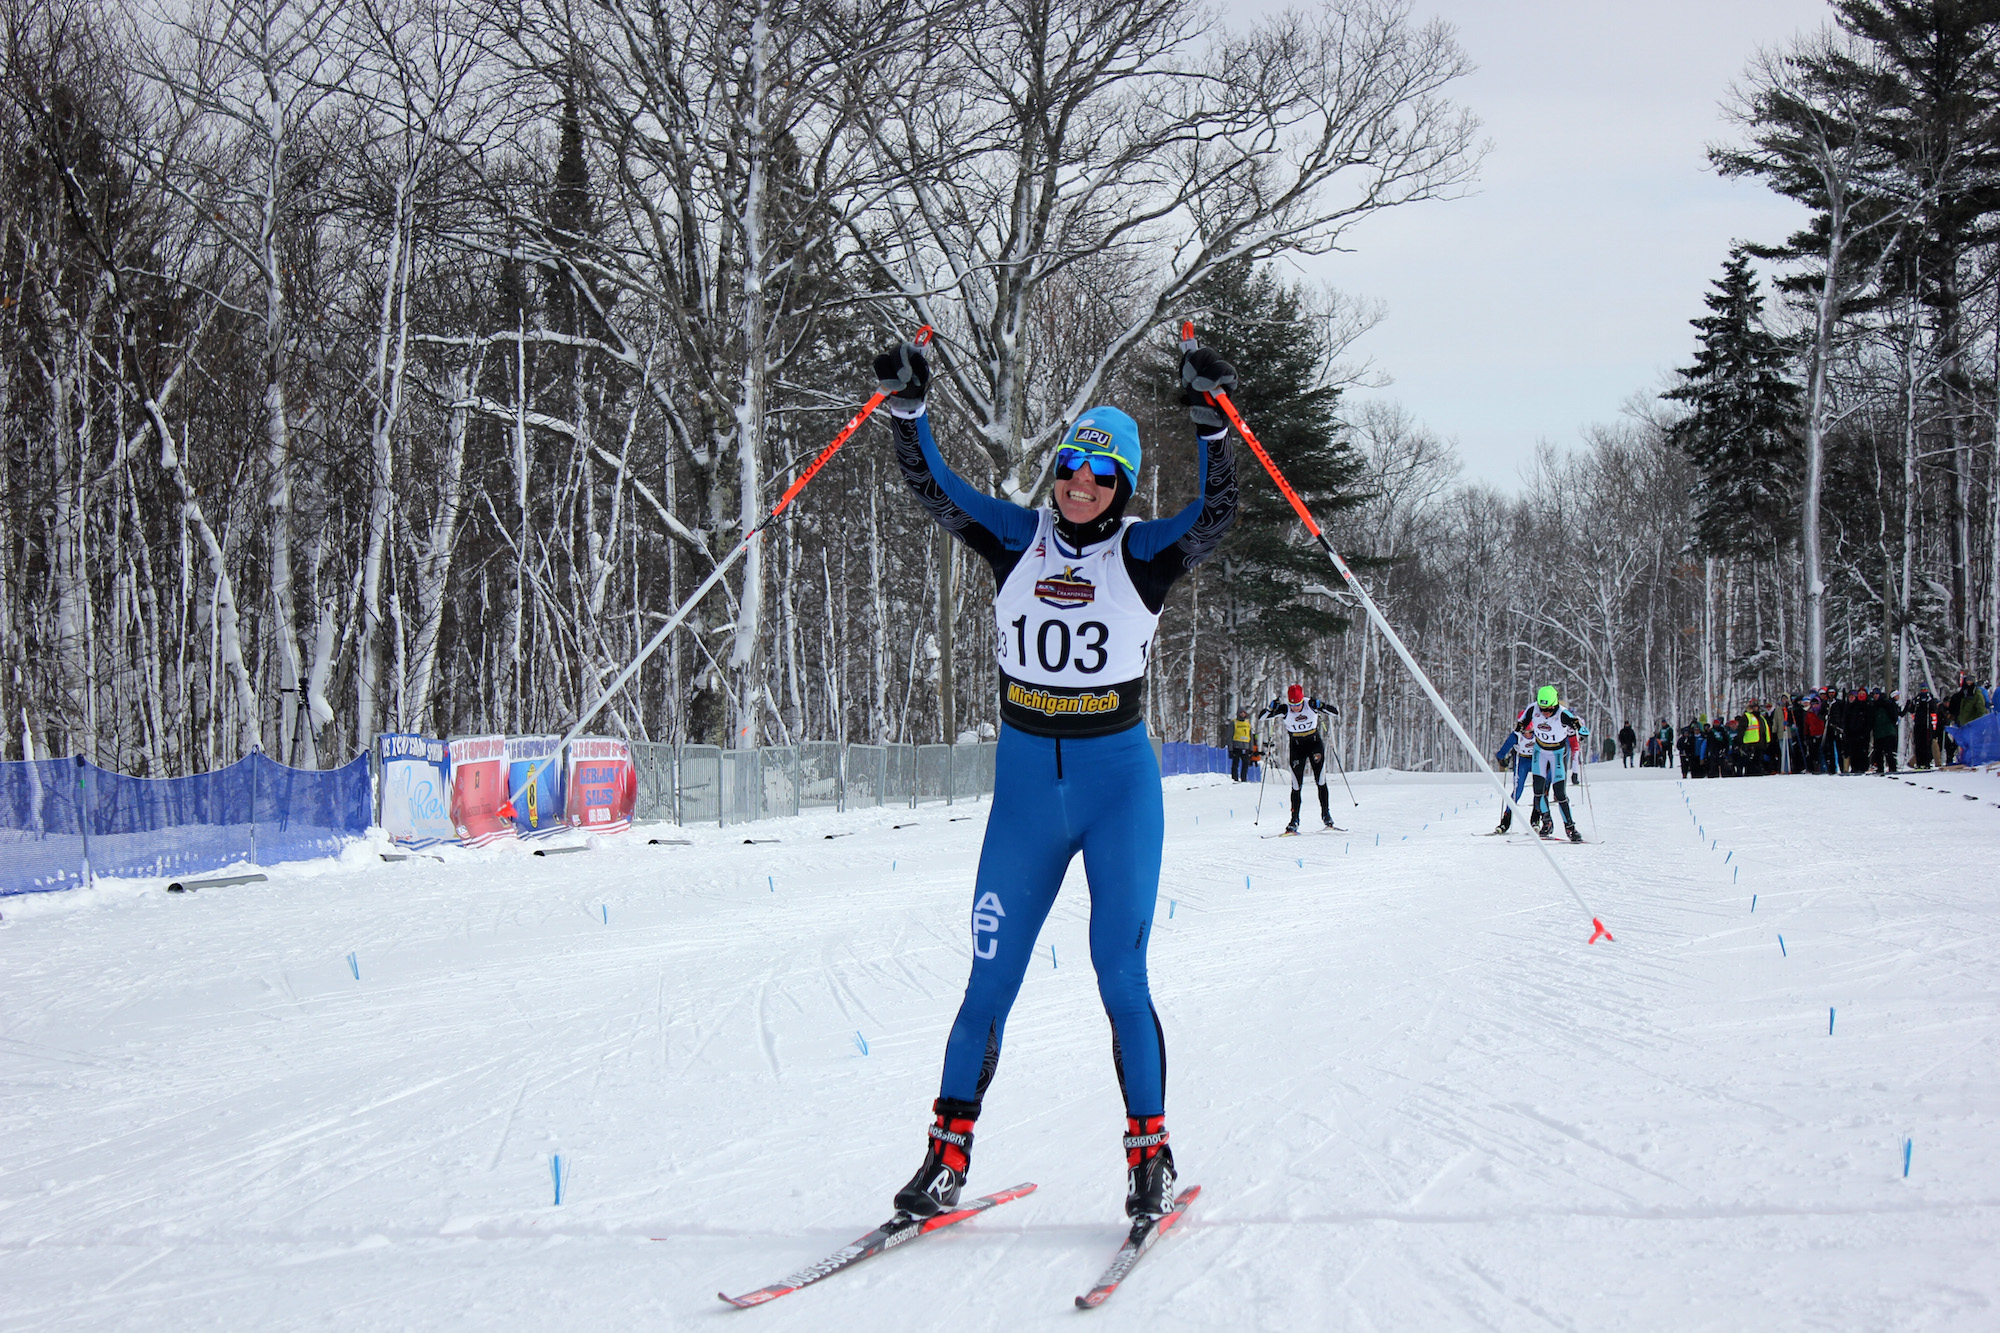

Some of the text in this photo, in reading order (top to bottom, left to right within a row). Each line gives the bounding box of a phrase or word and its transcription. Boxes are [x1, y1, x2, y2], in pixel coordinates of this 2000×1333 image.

[1077, 430, 1109, 445] APU
[1012, 614, 1109, 674] 103
[1291, 721, 1314, 731] 107
[585, 788, 614, 806] SALES
[973, 891, 1006, 960] APU
[884, 1223, 919, 1250] ROSSIGNOL
